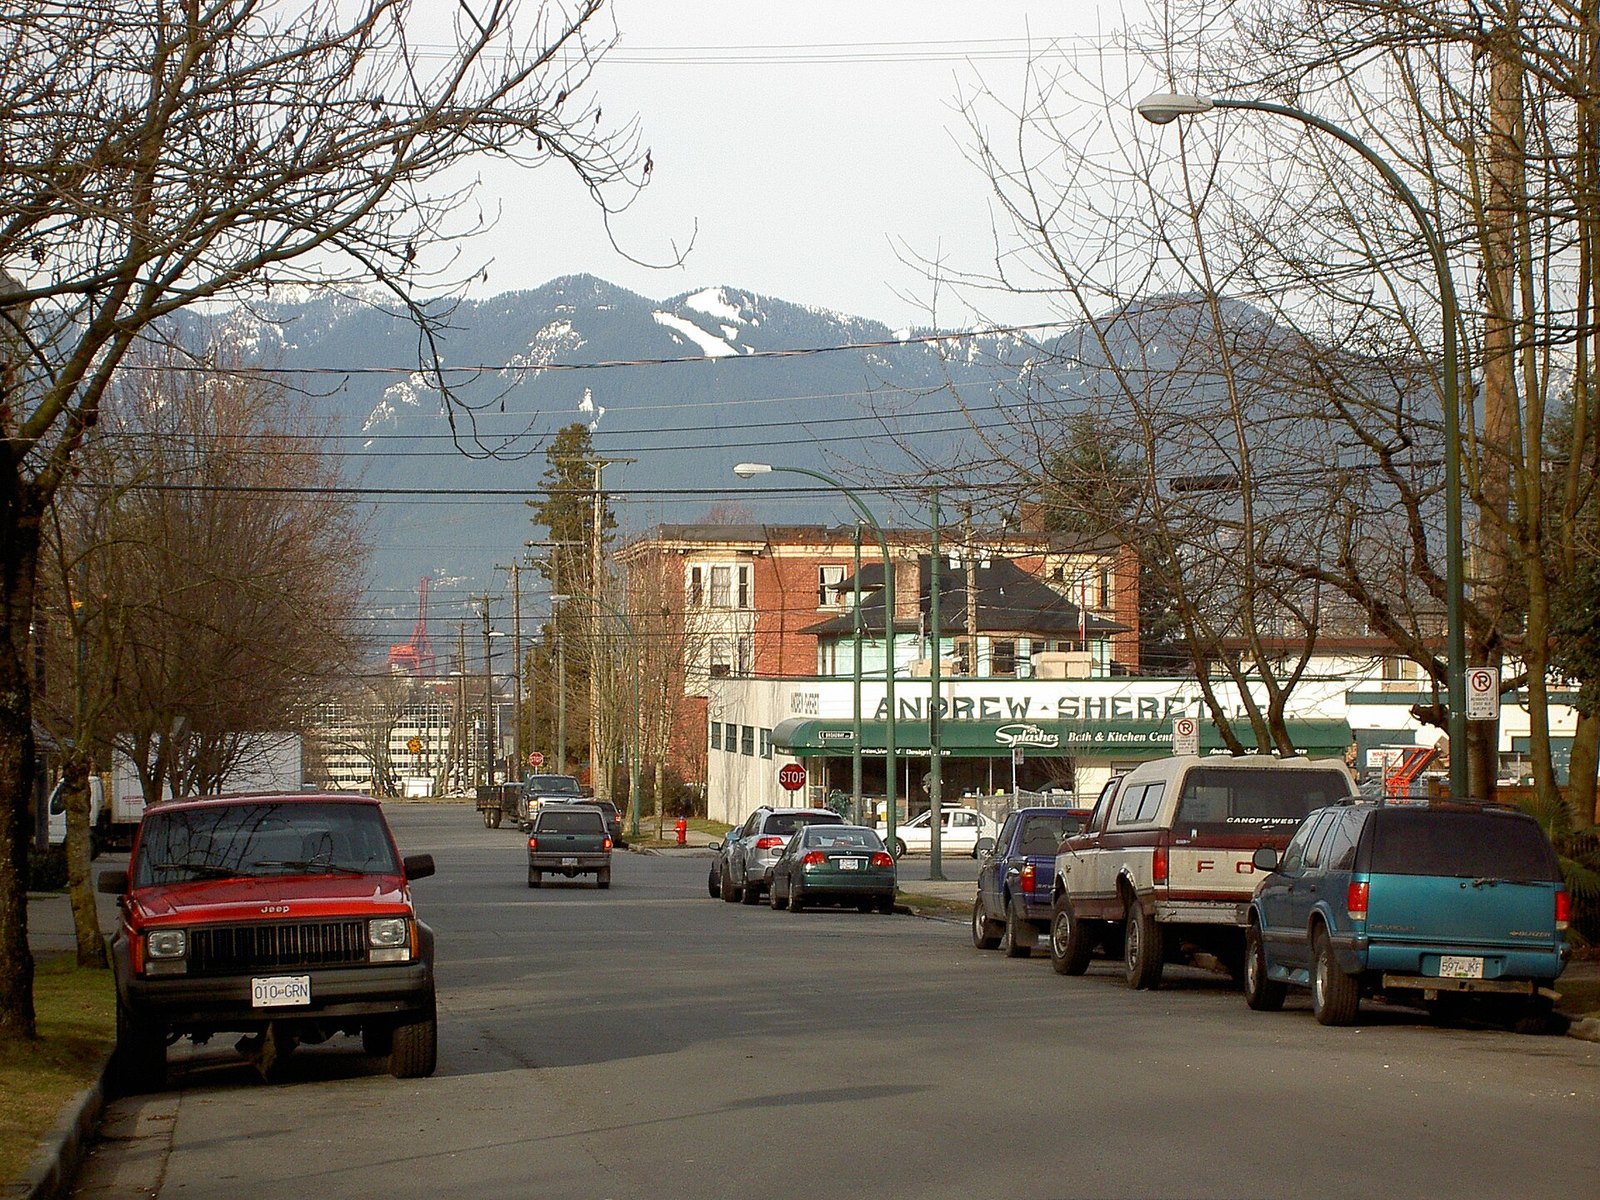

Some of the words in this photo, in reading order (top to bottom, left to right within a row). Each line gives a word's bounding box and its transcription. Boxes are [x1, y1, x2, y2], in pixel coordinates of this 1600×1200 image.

[873, 696, 1032, 720] ANDREW
[1057, 696, 1207, 720] SHERET
[995, 723, 1059, 748] Splashes
[1067, 732, 1092, 742] Bath
[1094, 732, 1105, 742] &
[1106, 732, 1147, 742] Kitchen
[1149, 731, 1174, 742] Cent
[780, 771, 806, 783] STOP
[1226, 816, 1271, 824] CANOPY
[1197, 860, 1255, 874] FO
[260, 905, 290, 914] Jeep
